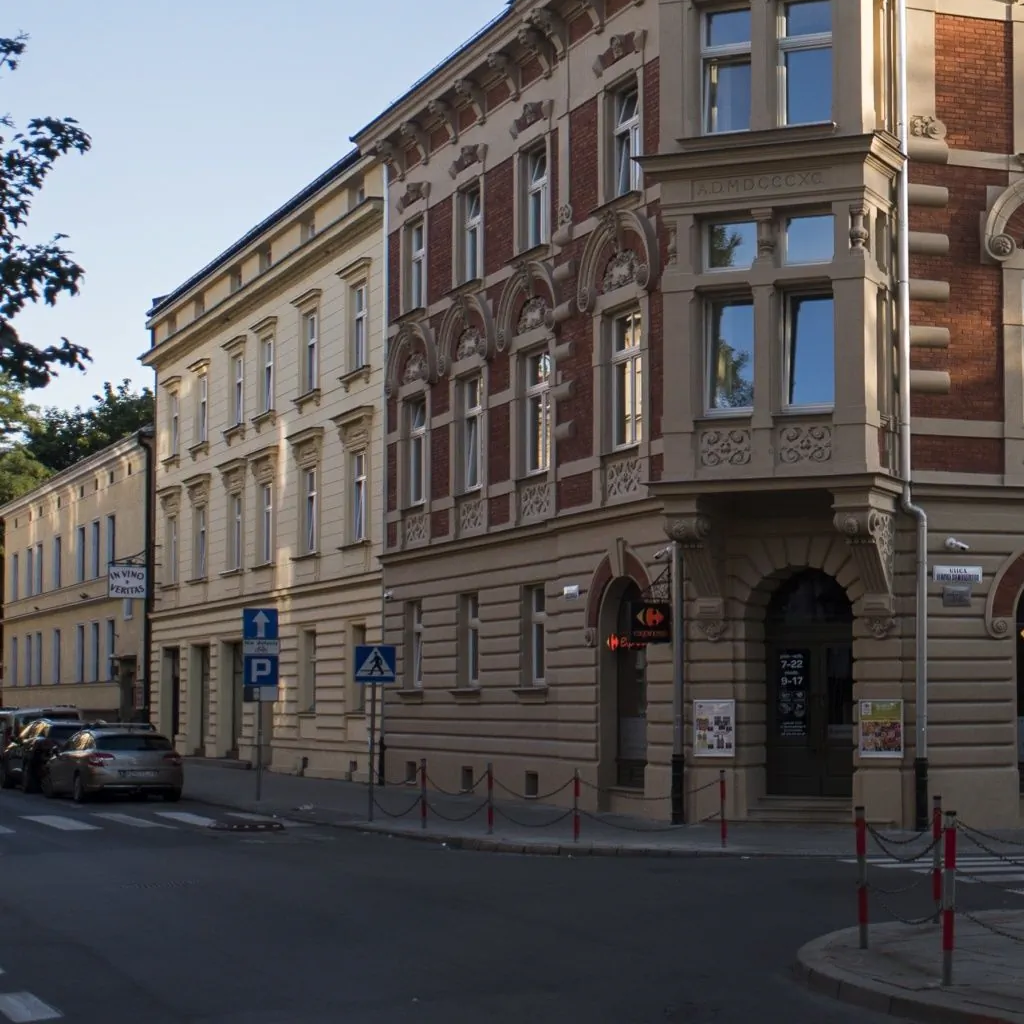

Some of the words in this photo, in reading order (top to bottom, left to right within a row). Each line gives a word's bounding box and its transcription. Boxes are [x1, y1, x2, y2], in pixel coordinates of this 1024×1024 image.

[110, 571, 120, 580] IN
[121, 570, 144, 580] VINO
[110, 584, 145, 594] VERITAS
[780, 660, 804, 669] 7-22
[251, 658, 272, 683] P
